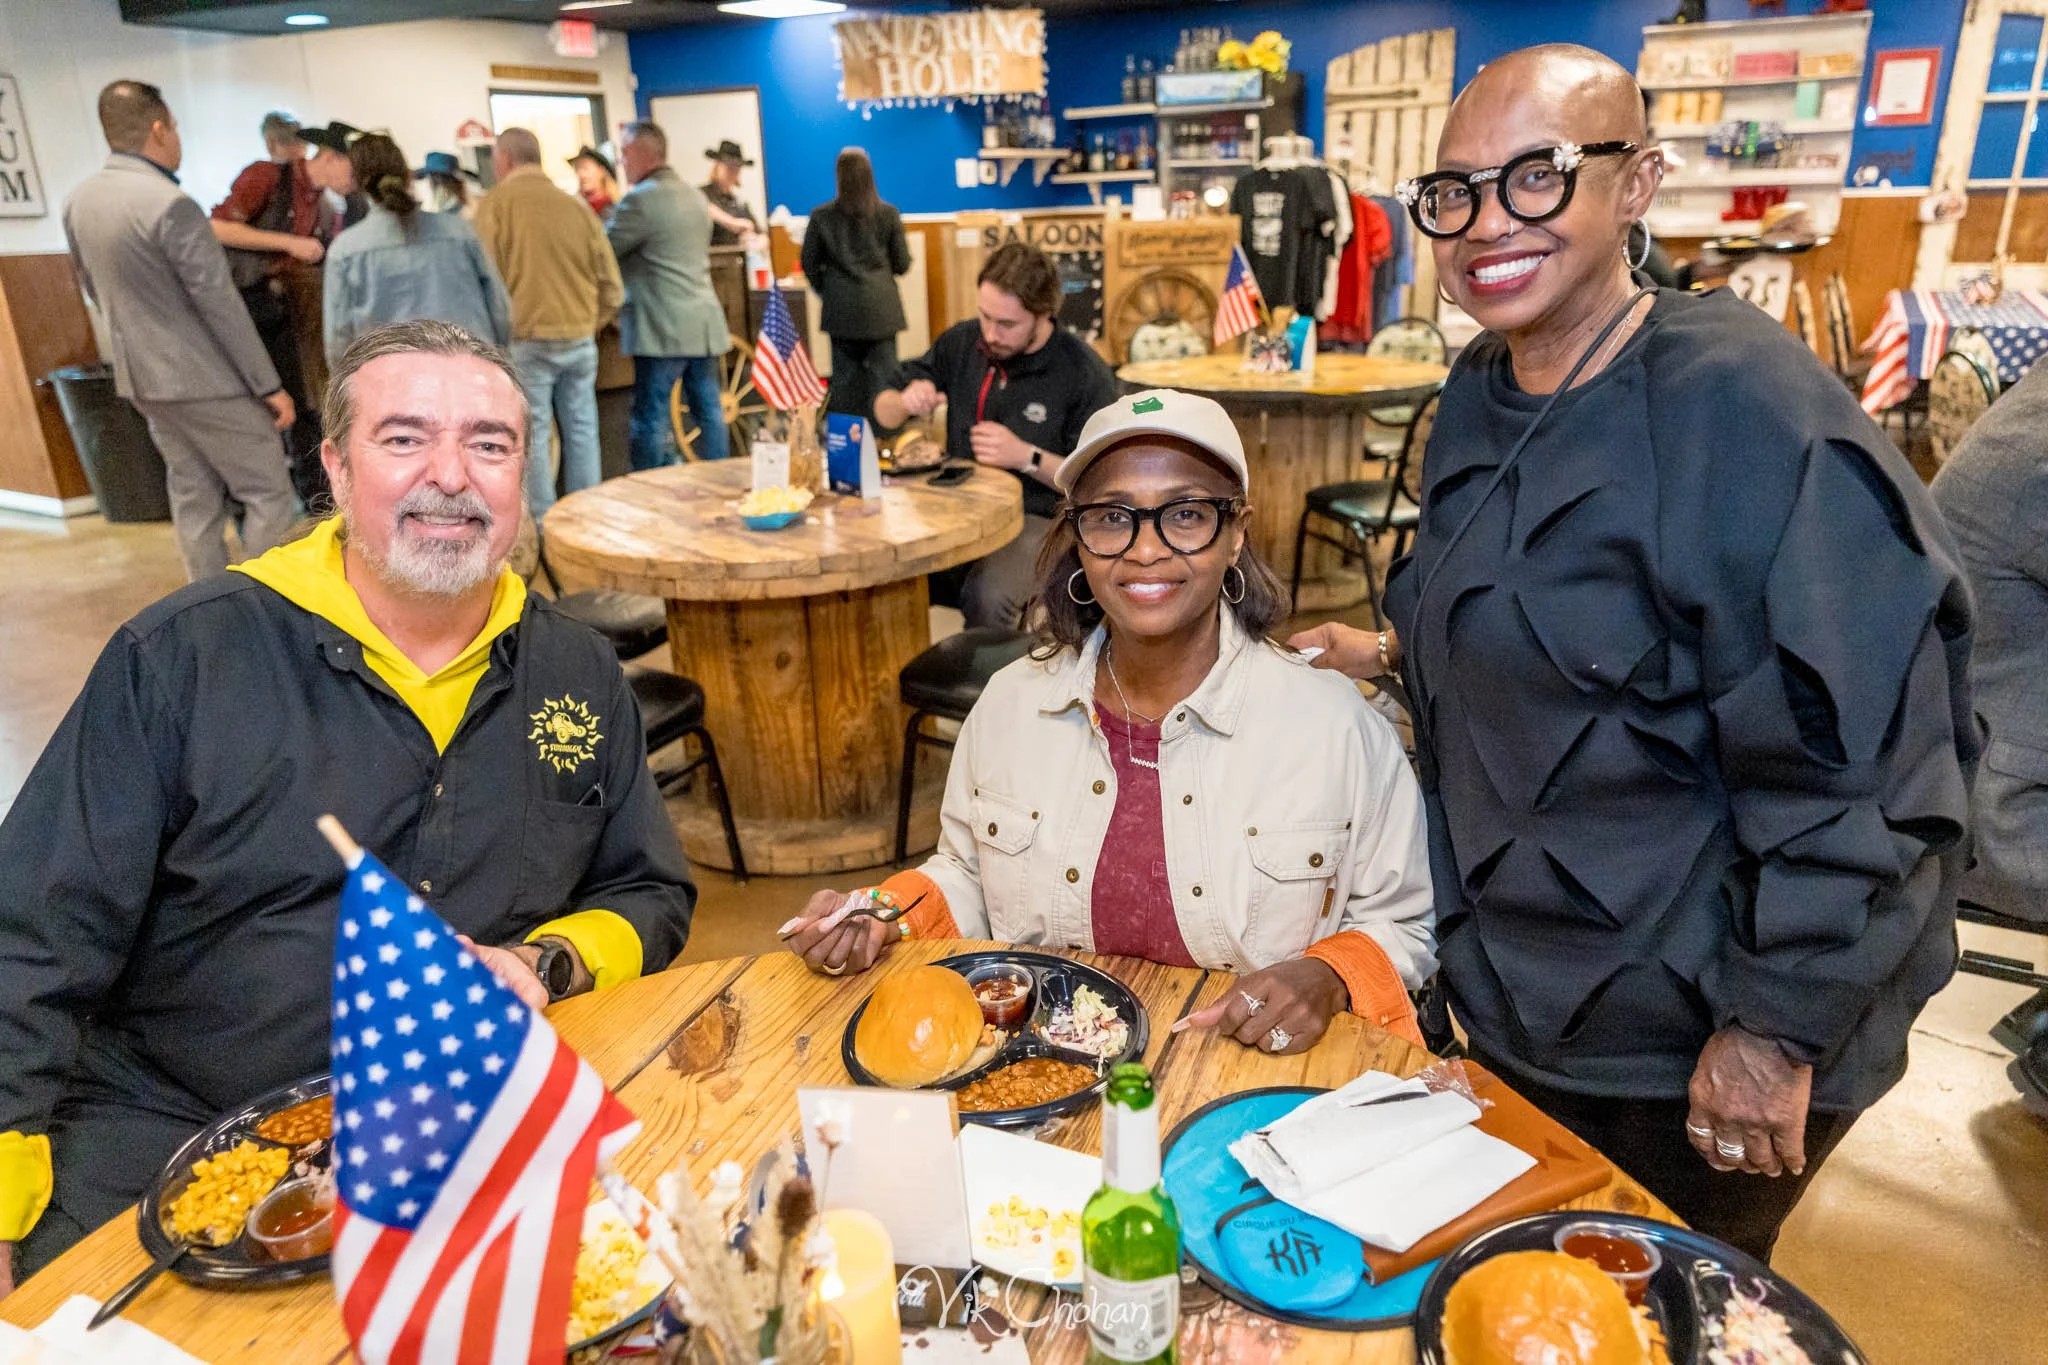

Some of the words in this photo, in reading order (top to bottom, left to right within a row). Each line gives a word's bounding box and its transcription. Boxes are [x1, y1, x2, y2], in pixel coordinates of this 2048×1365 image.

[836, 9, 1041, 58] WATERING
[876, 52, 1000, 98] HOLE
[984, 223, 1103, 249] SALOON
